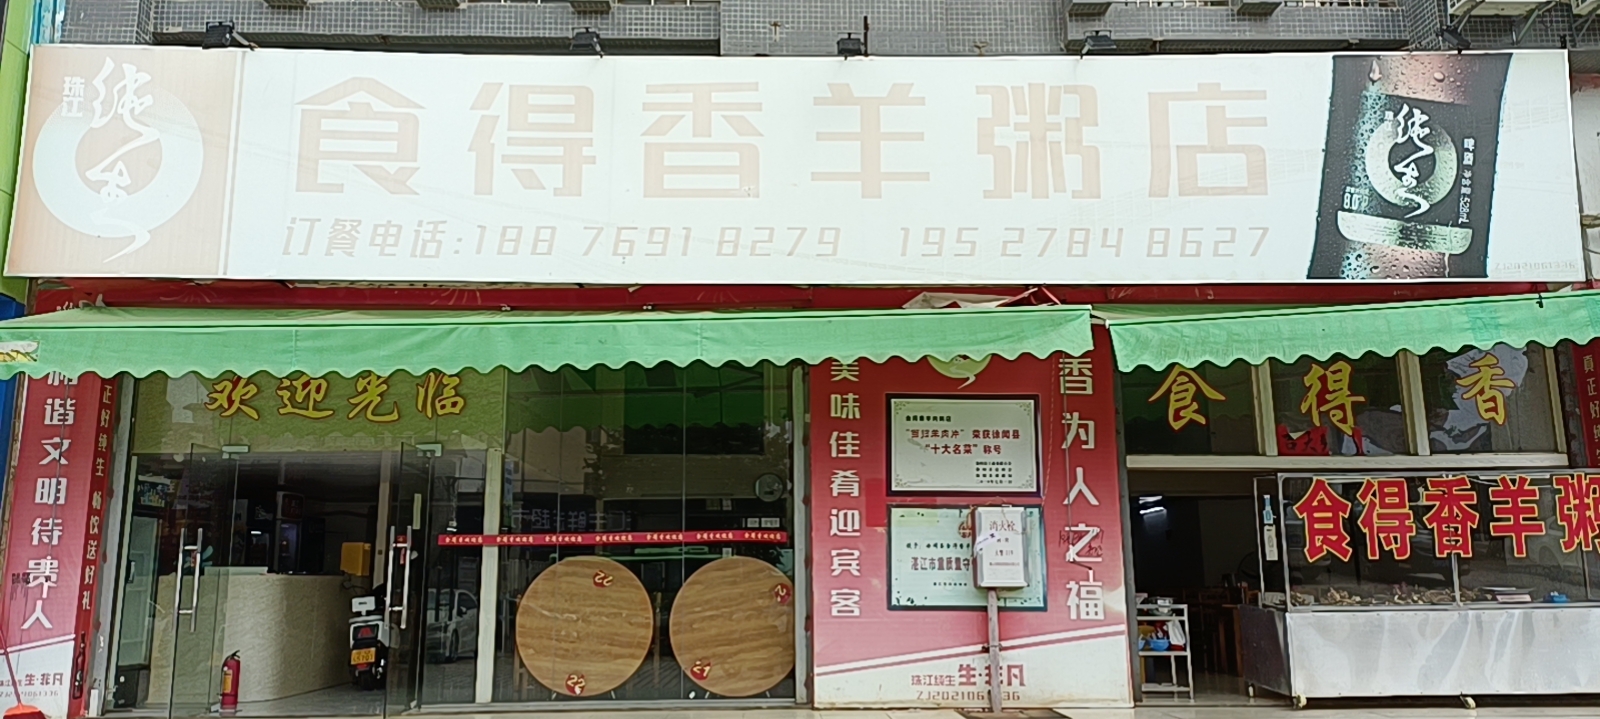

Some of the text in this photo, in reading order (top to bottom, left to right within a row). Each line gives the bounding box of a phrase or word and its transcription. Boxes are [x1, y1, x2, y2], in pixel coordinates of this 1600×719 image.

[62, 76, 85, 118] 珠江
[295, 76, 1268, 200] 食得香羊粥店
[582, 226, 693, 257] 7691
[715, 226, 841, 258] 8279
[899, 226, 979, 258] 195
[1000, 226, 1124, 258] 2784
[1146, 226, 1270, 258] 8627
[205, 373, 466, 422] 欢迎光临
[1148, 354, 1515, 436] 食得香
[829, 360, 861, 617] 美味佳肴迎宾客
[1058, 357, 1105, 620] 香为人之福
[1293, 474, 1600, 563] 食得香羊粥
[989, 520, 1016, 532] 消火栓
[916, 690, 1021, 701] ZJ20210636
